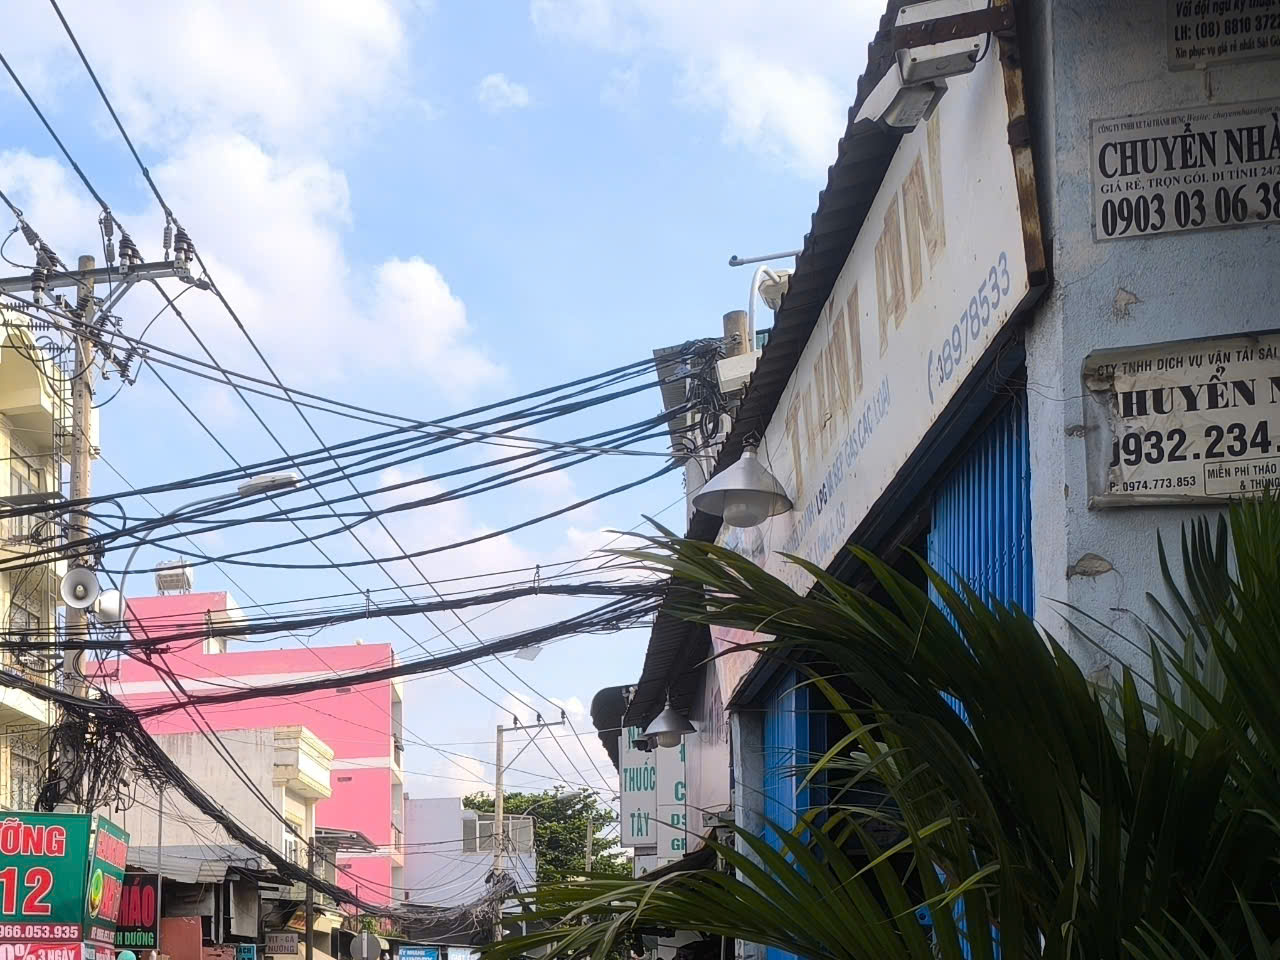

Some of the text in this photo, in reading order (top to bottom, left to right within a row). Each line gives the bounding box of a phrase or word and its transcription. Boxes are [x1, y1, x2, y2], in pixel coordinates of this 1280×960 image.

[1098, 122, 1217, 178] CHUYỂN
[1101, 193, 1166, 237] 0903
[1174, 189, 1207, 228] 03
[1215, 184, 1248, 224] 06
[1097, 363, 1117, 376] CTY
[1122, 359, 1152, 374] TNHH
[1157, 356, 1183, 372] DỊCH
[1188, 354, 1203, 369] VỤ
[1208, 349, 1231, 366] VẬN
[1236, 346, 1254, 362] TẢI
[1114, 366, 1256, 419] HUYỂN
[1122, 476, 1196, 492] 0974.773.853
[1208, 461, 1277, 479] MIỄN PHÍ THÁO
[623, 756, 656, 793] THUỐC
[630, 807, 650, 837] TÂY
